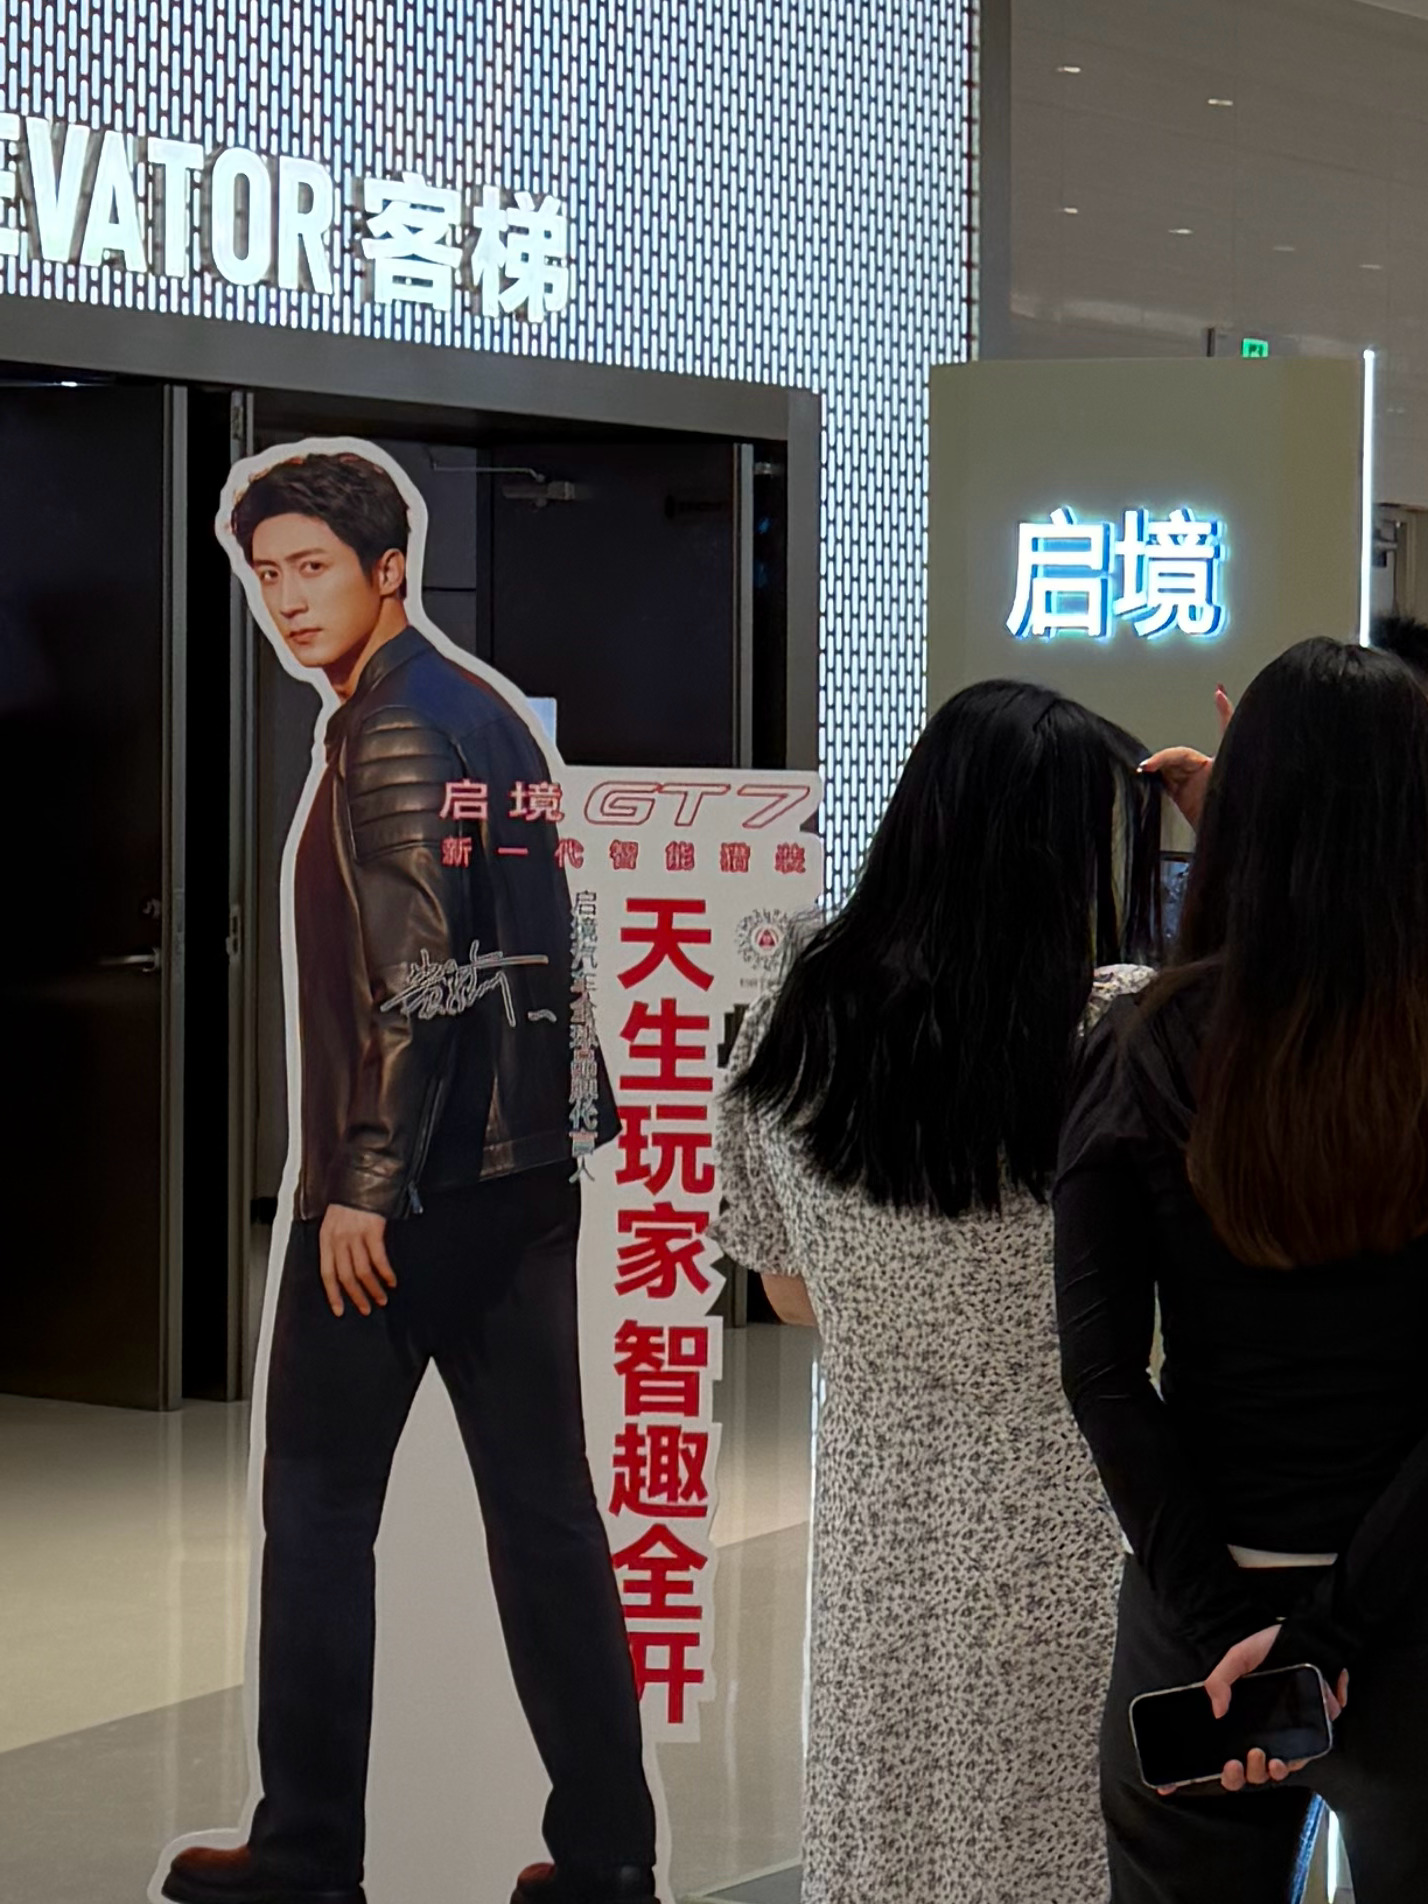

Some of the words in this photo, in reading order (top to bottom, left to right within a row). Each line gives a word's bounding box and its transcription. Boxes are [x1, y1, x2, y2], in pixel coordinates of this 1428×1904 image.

[362, 172, 570, 323] 客梯
[1006, 507, 1226, 640] 启境
[439, 779, 564, 824] 启境
[584, 781, 810, 829] GT7
